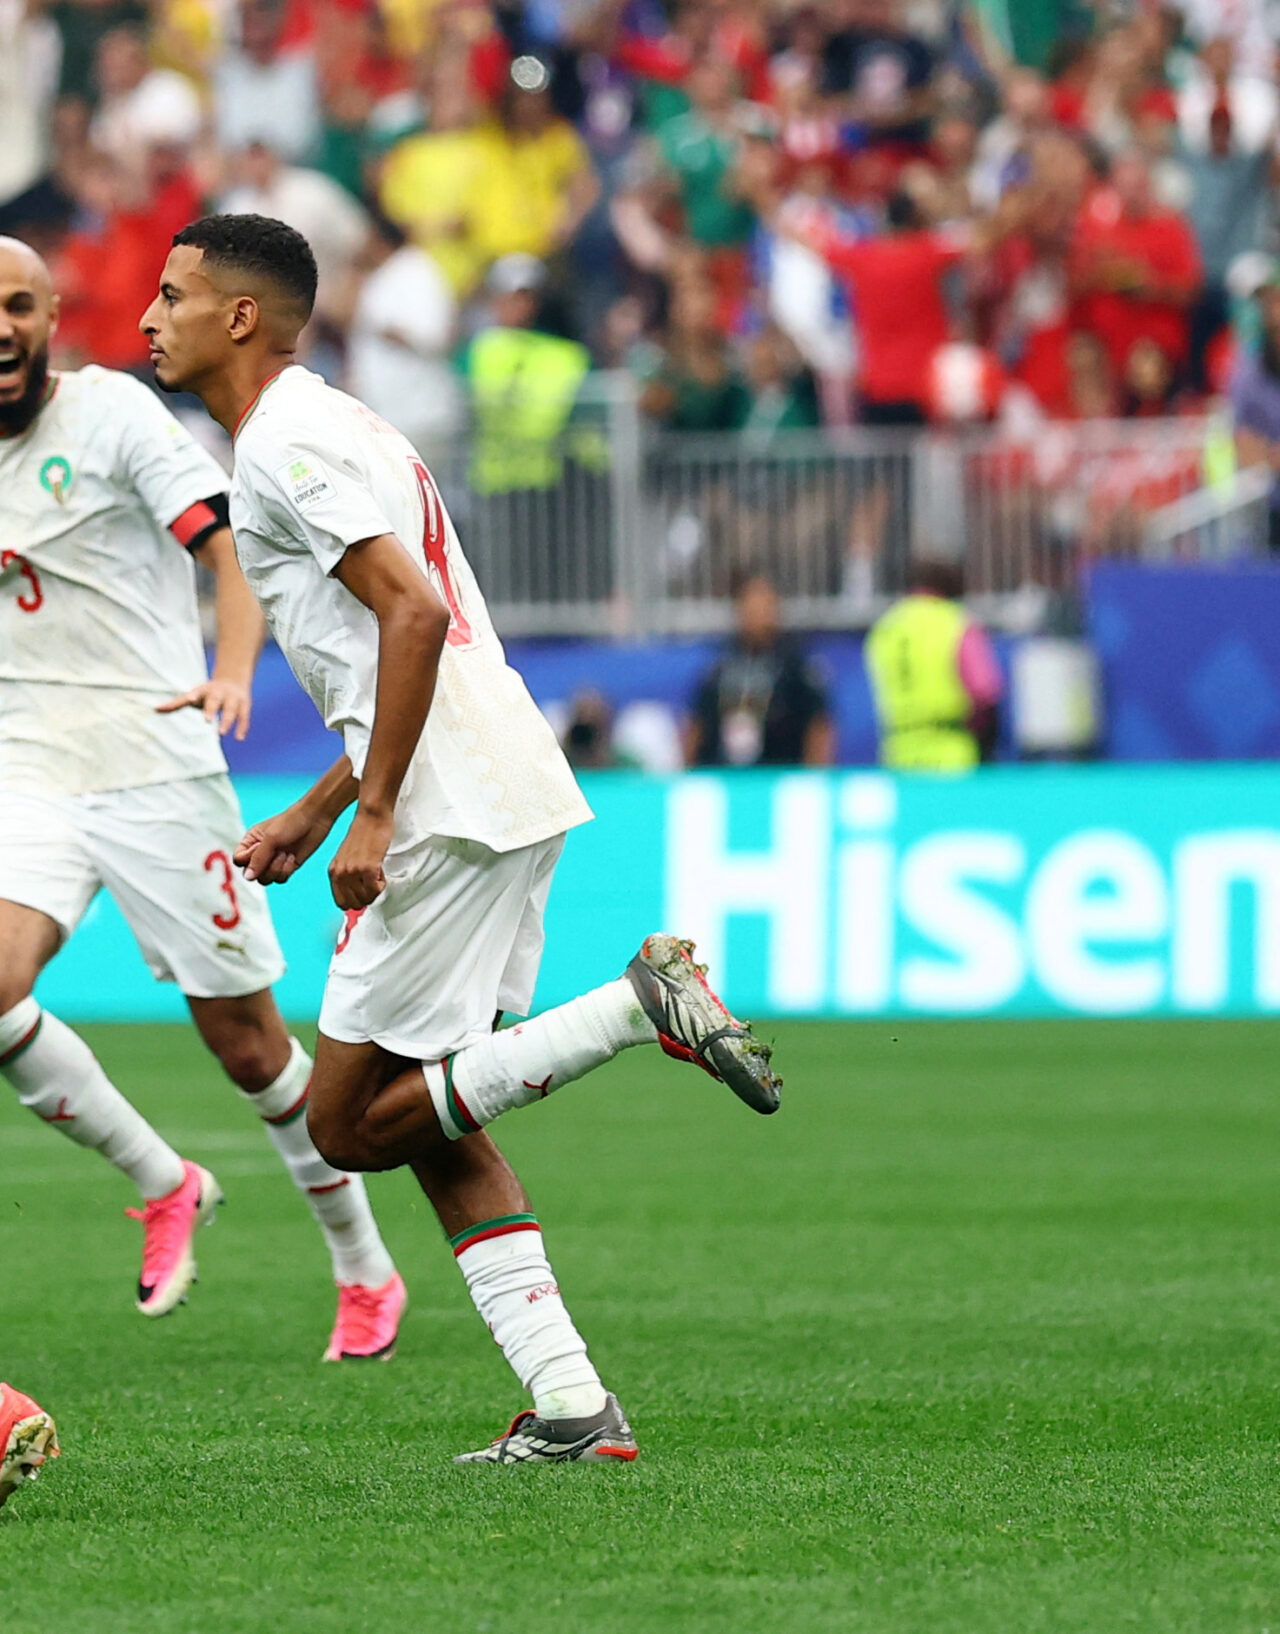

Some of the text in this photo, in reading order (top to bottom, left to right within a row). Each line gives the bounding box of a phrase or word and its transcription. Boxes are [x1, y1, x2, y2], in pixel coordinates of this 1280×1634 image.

[1, 549, 43, 613] 3
[204, 850, 242, 930] 3
[665, 772, 1280, 1014] Hisen
